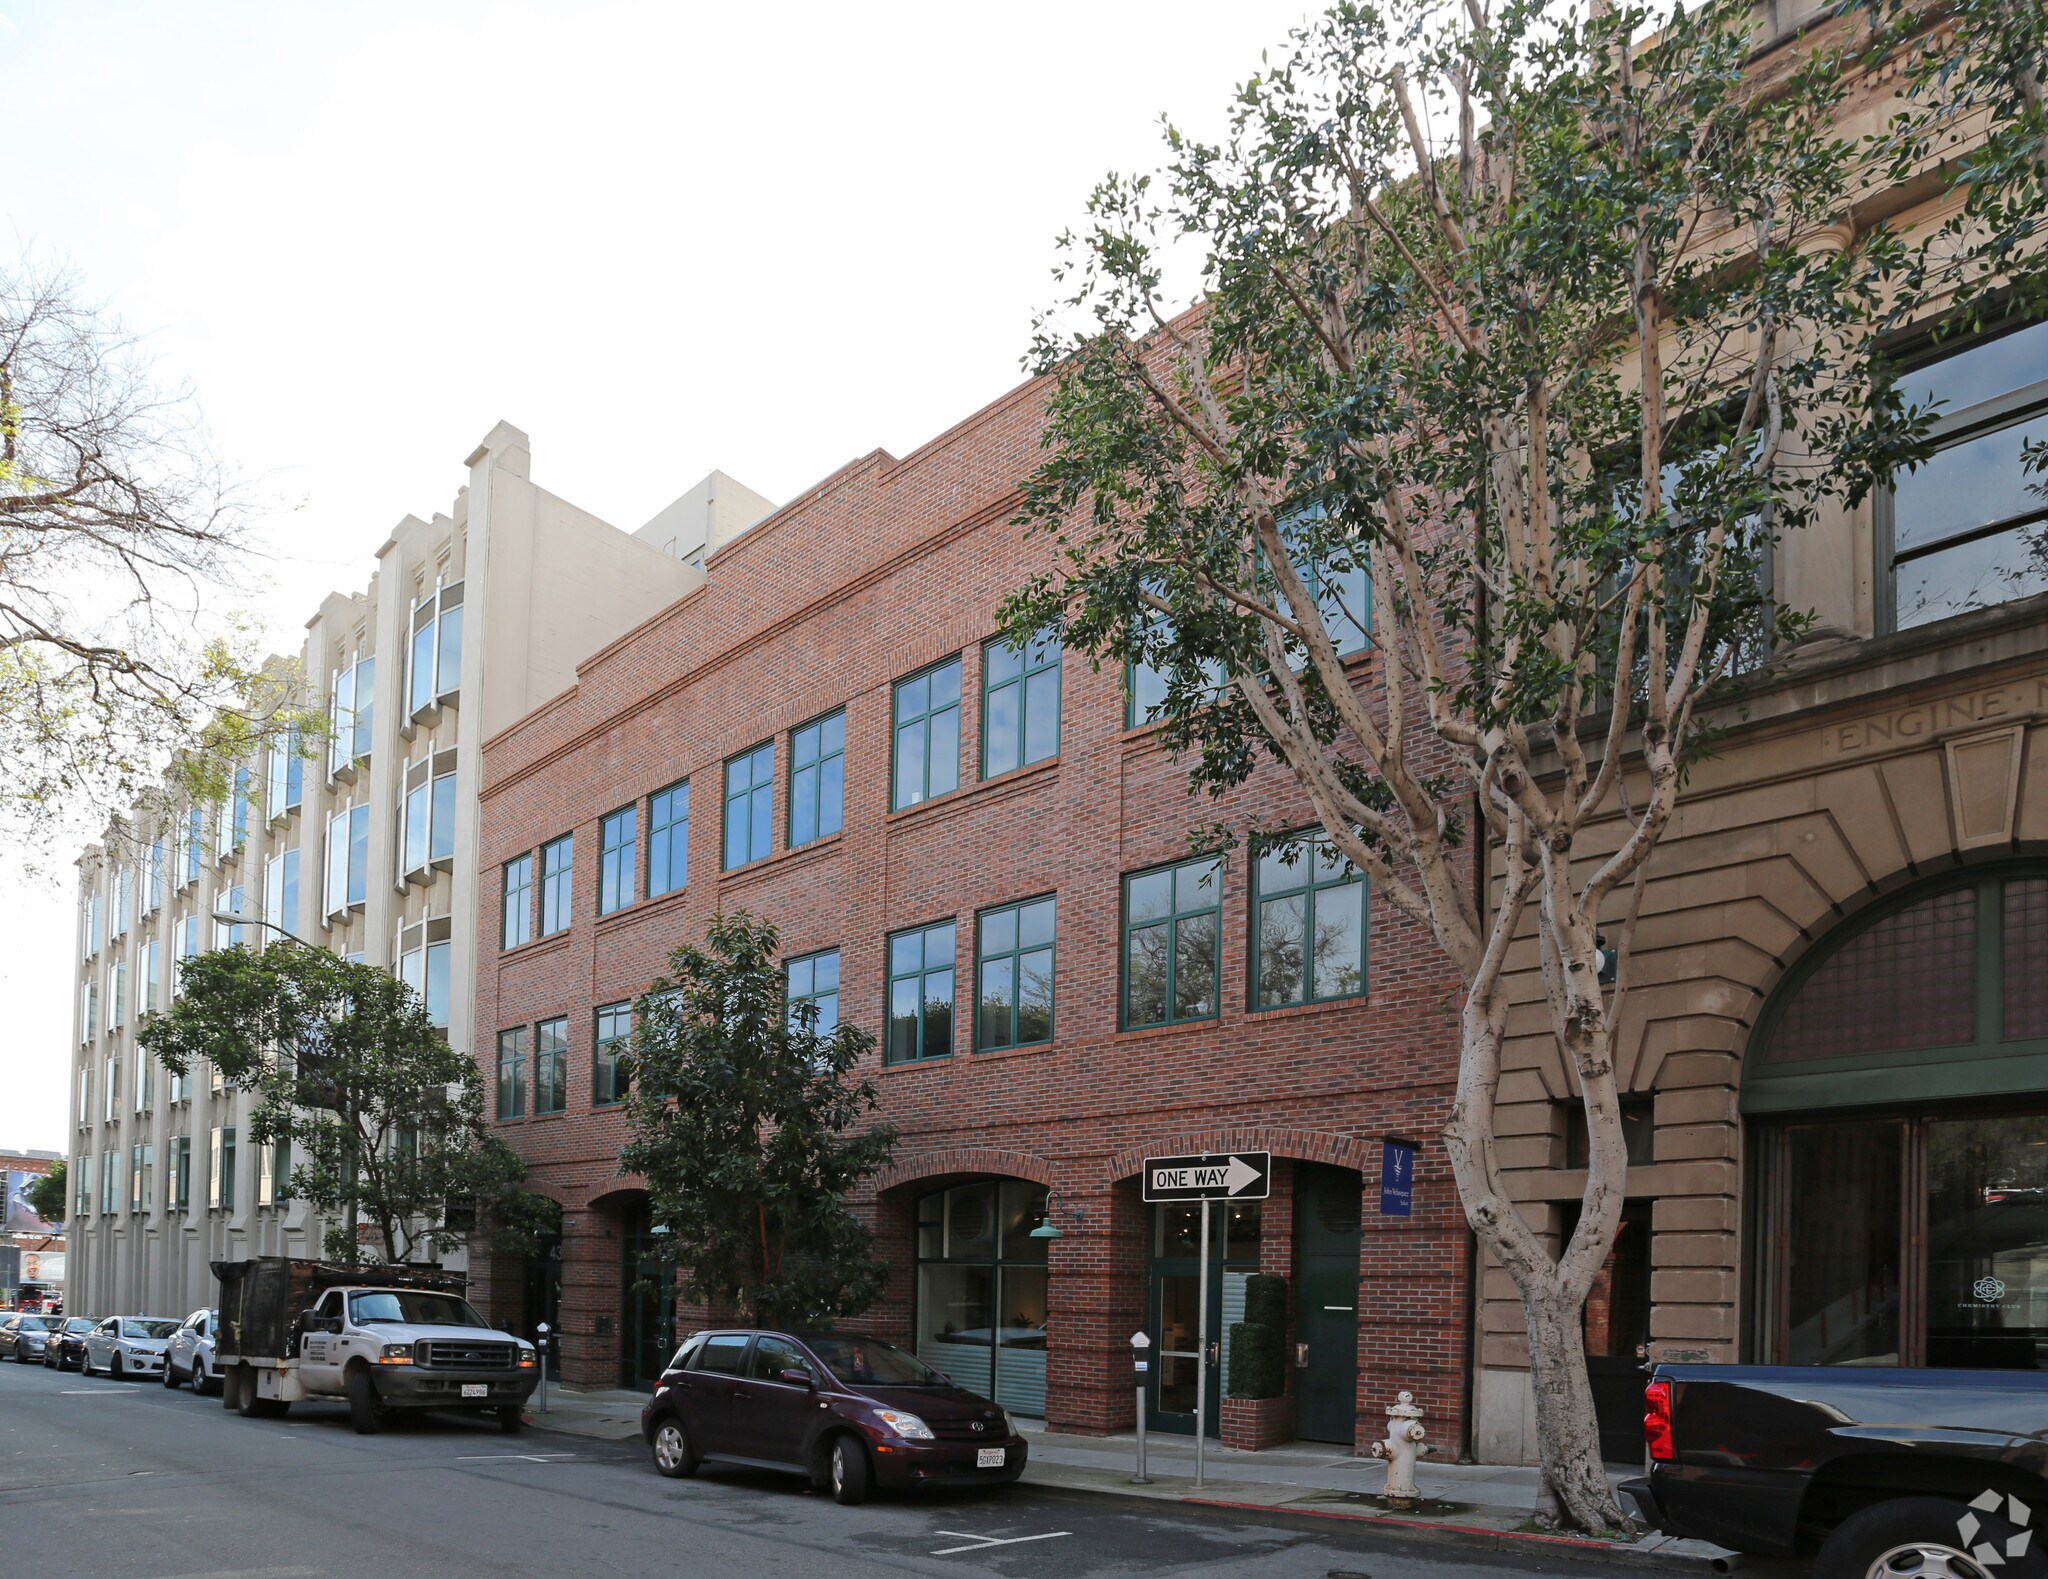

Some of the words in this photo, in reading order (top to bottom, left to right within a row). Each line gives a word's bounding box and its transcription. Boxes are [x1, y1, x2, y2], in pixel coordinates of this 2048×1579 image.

[1837, 689, 2009, 752] ENGINE
[1156, 1170, 1188, 1188] ONE
[1194, 1168, 1229, 1186] WAY
